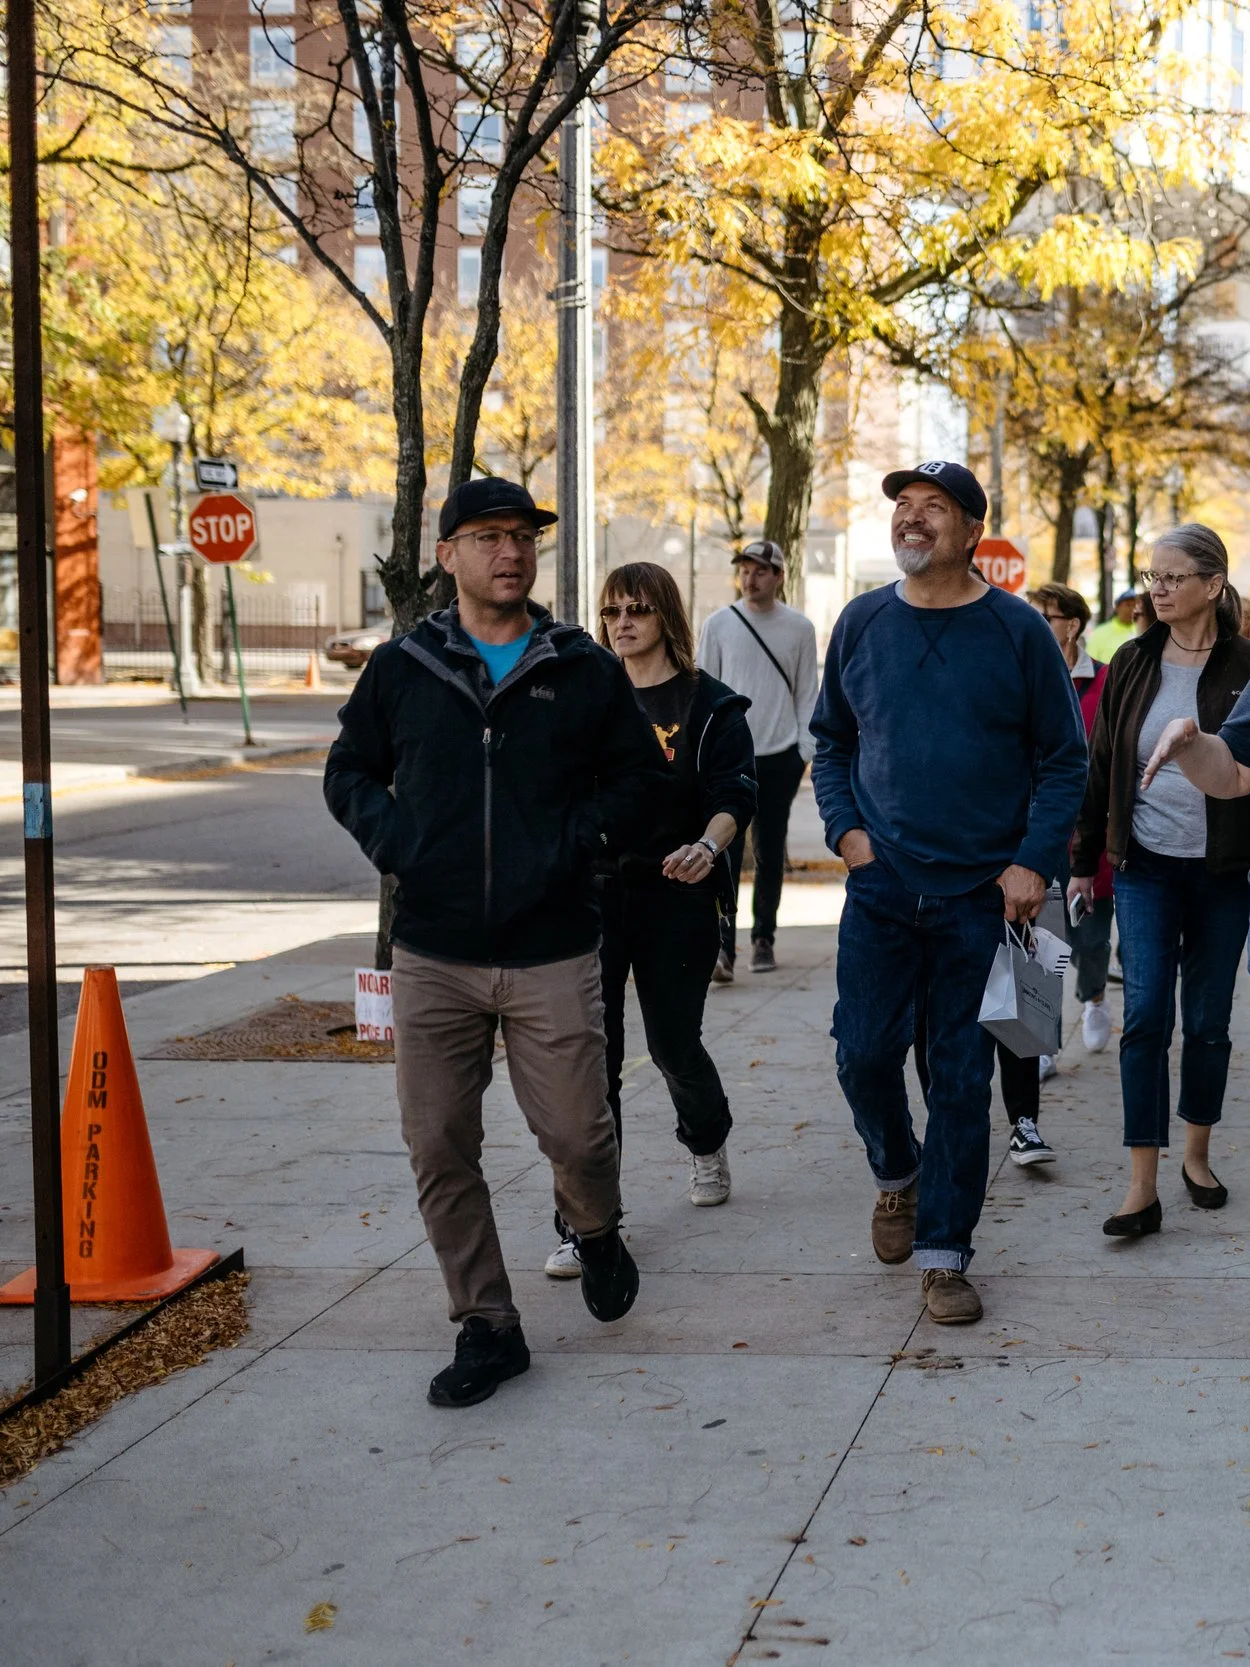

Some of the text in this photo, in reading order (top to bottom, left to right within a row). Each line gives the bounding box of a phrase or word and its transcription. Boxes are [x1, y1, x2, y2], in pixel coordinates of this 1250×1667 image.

[192, 512, 251, 545] STOP
[974, 556, 1023, 584] TOP
[79, 1051, 108, 1258] ODM PARKING
